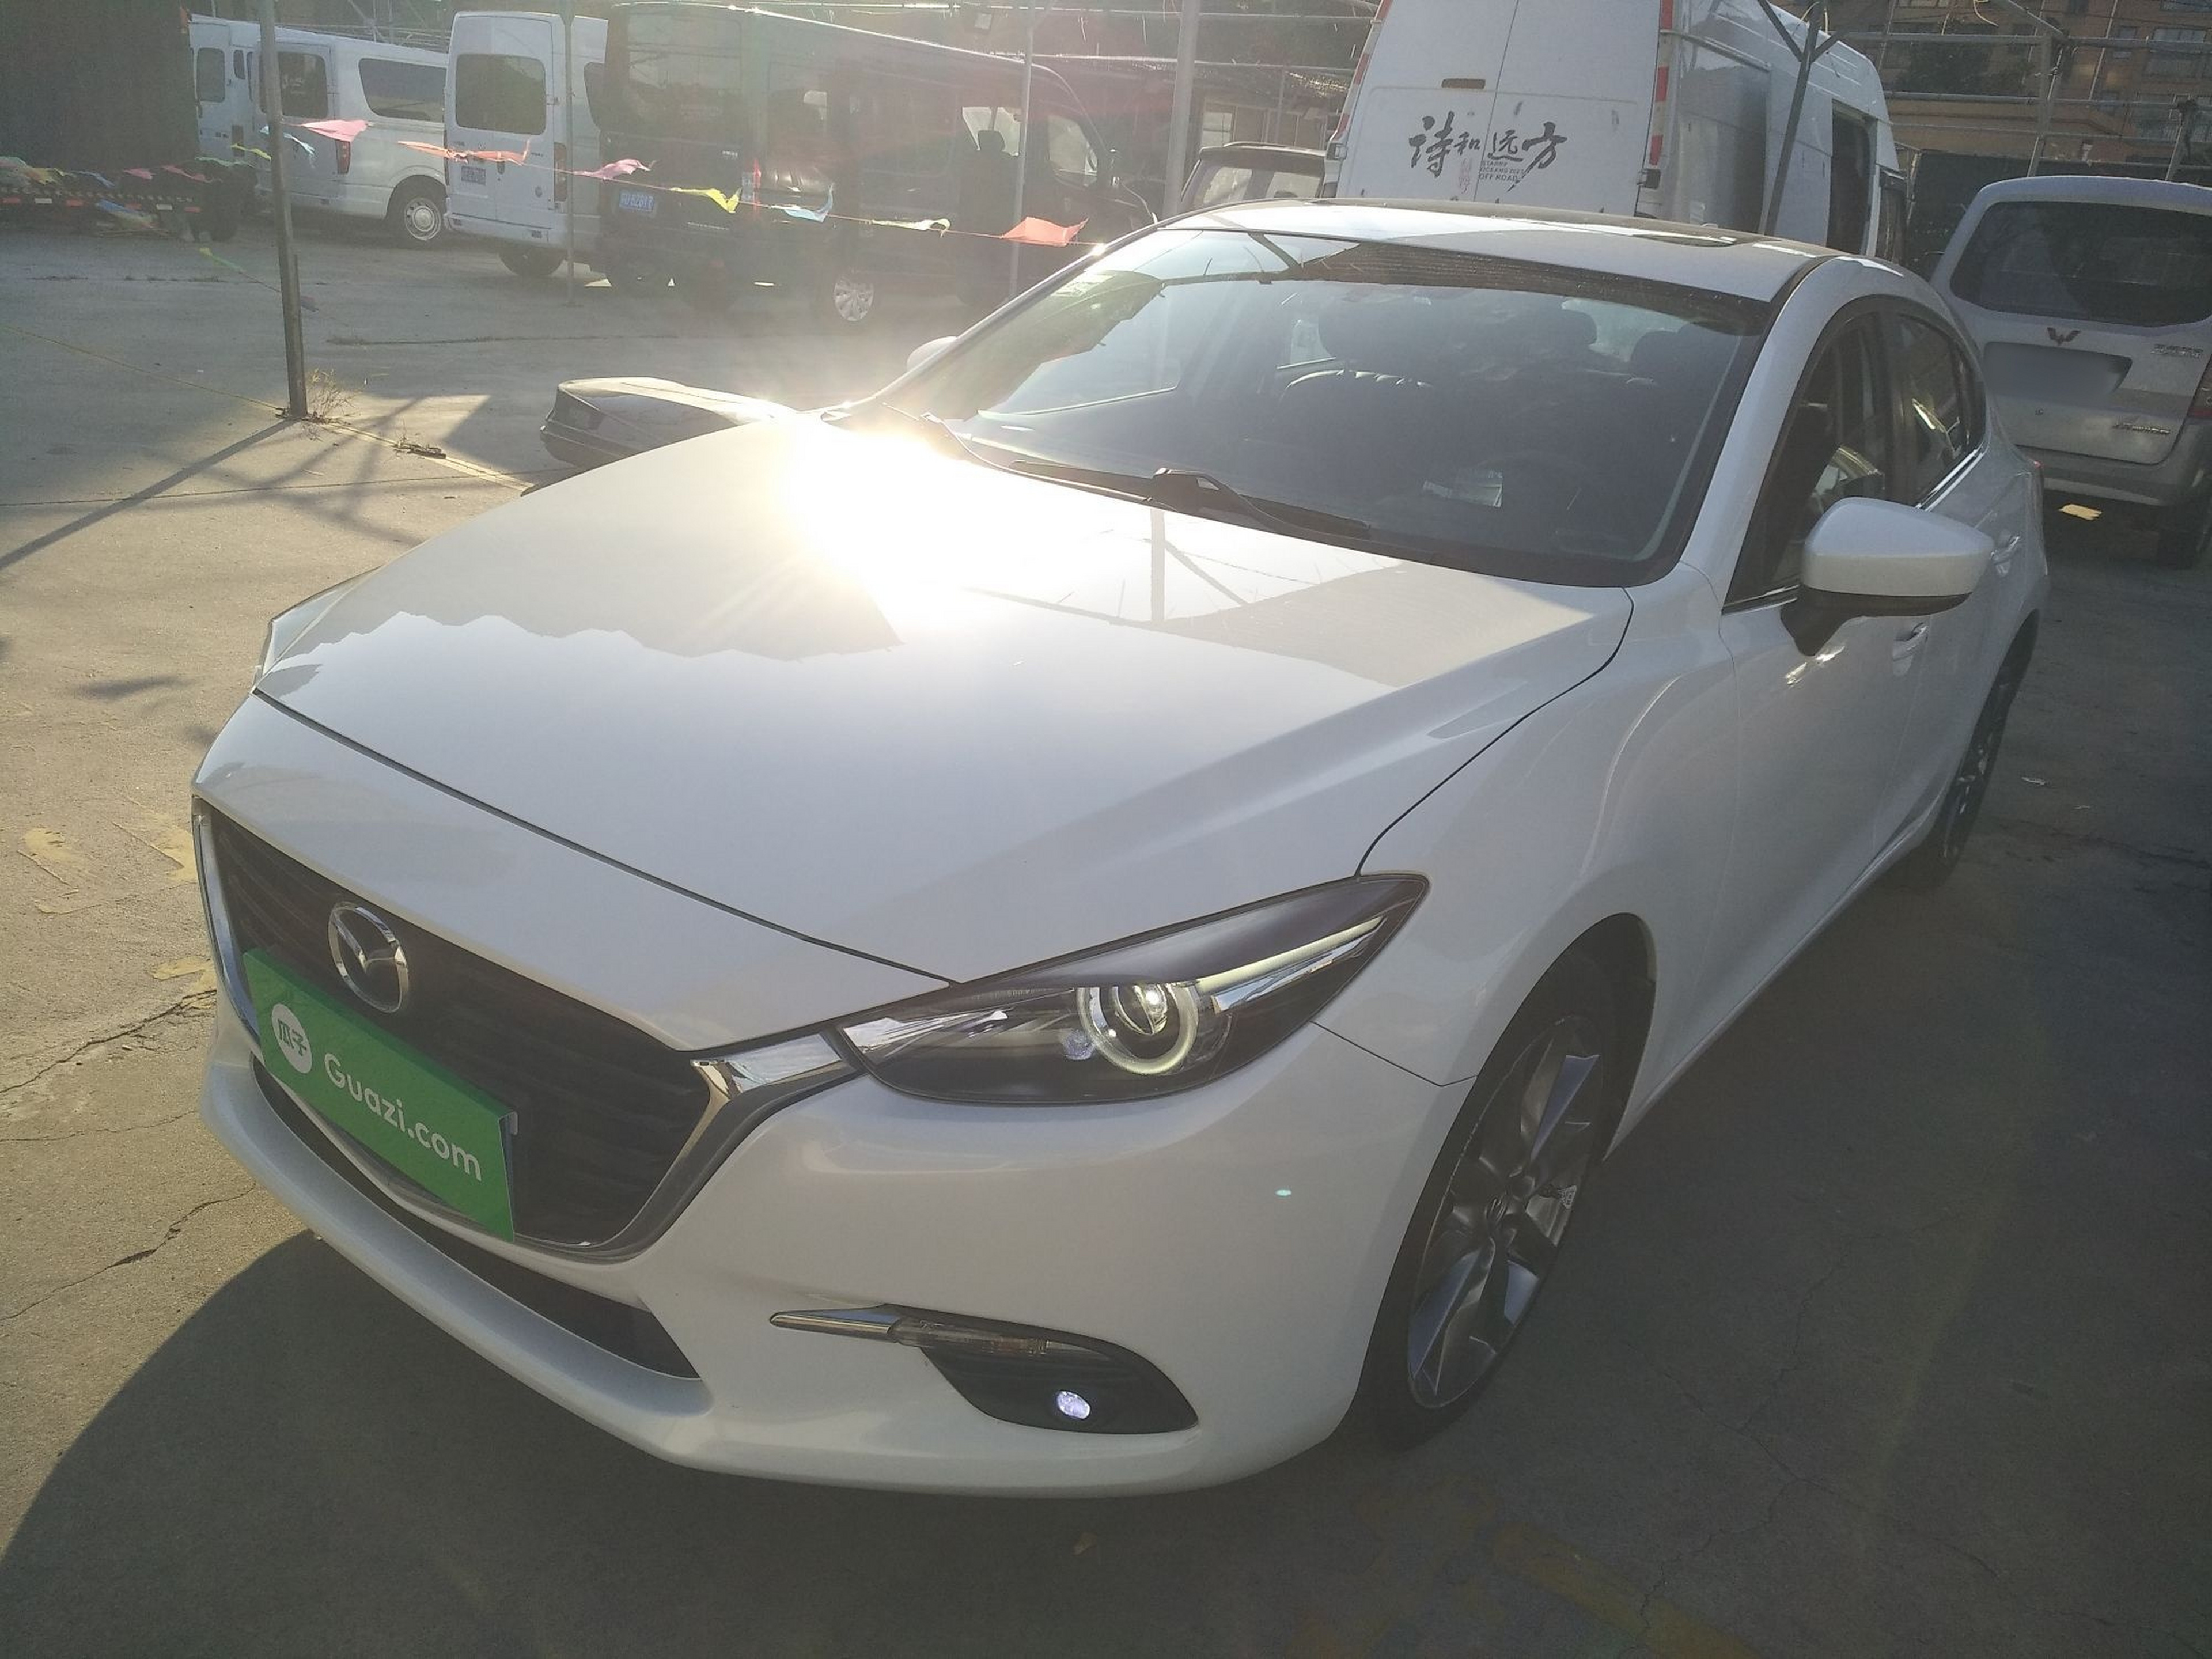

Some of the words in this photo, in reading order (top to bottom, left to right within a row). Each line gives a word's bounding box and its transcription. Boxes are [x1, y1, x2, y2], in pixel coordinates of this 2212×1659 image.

[1409, 111, 1567, 192] 诗和远方
[278, 1018, 306, 1056] 瓜子
[324, 1052, 482, 1181] Guazi.com
